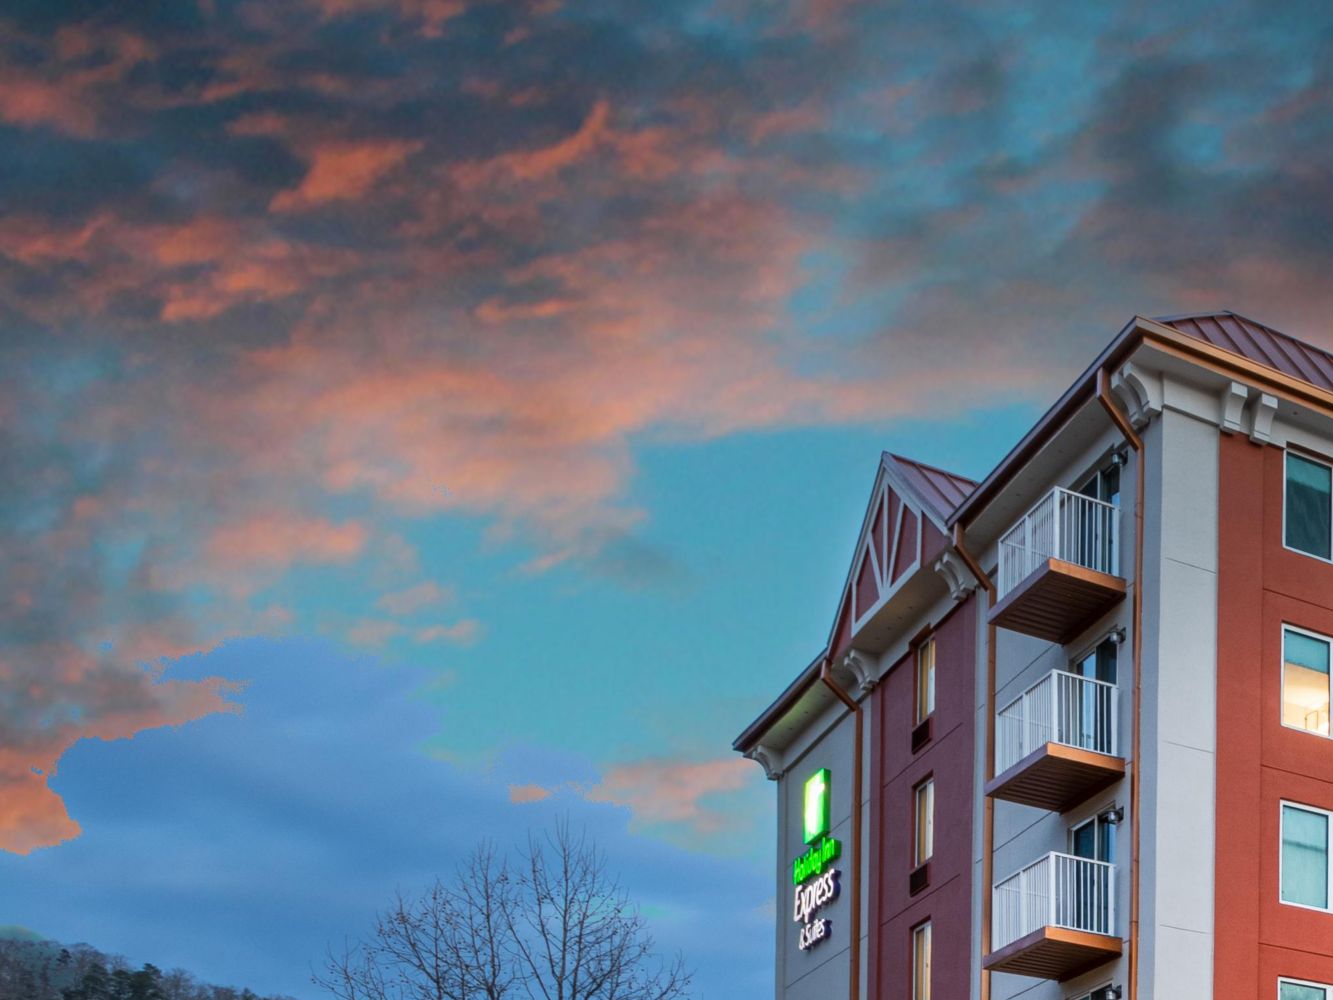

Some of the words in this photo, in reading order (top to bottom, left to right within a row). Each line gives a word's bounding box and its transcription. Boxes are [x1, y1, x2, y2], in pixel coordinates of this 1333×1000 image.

[793, 846, 822, 886] Holiday
[821, 836, 836, 863] Inn
[793, 868, 835, 924] Express
[804, 918, 826, 947] Suites
